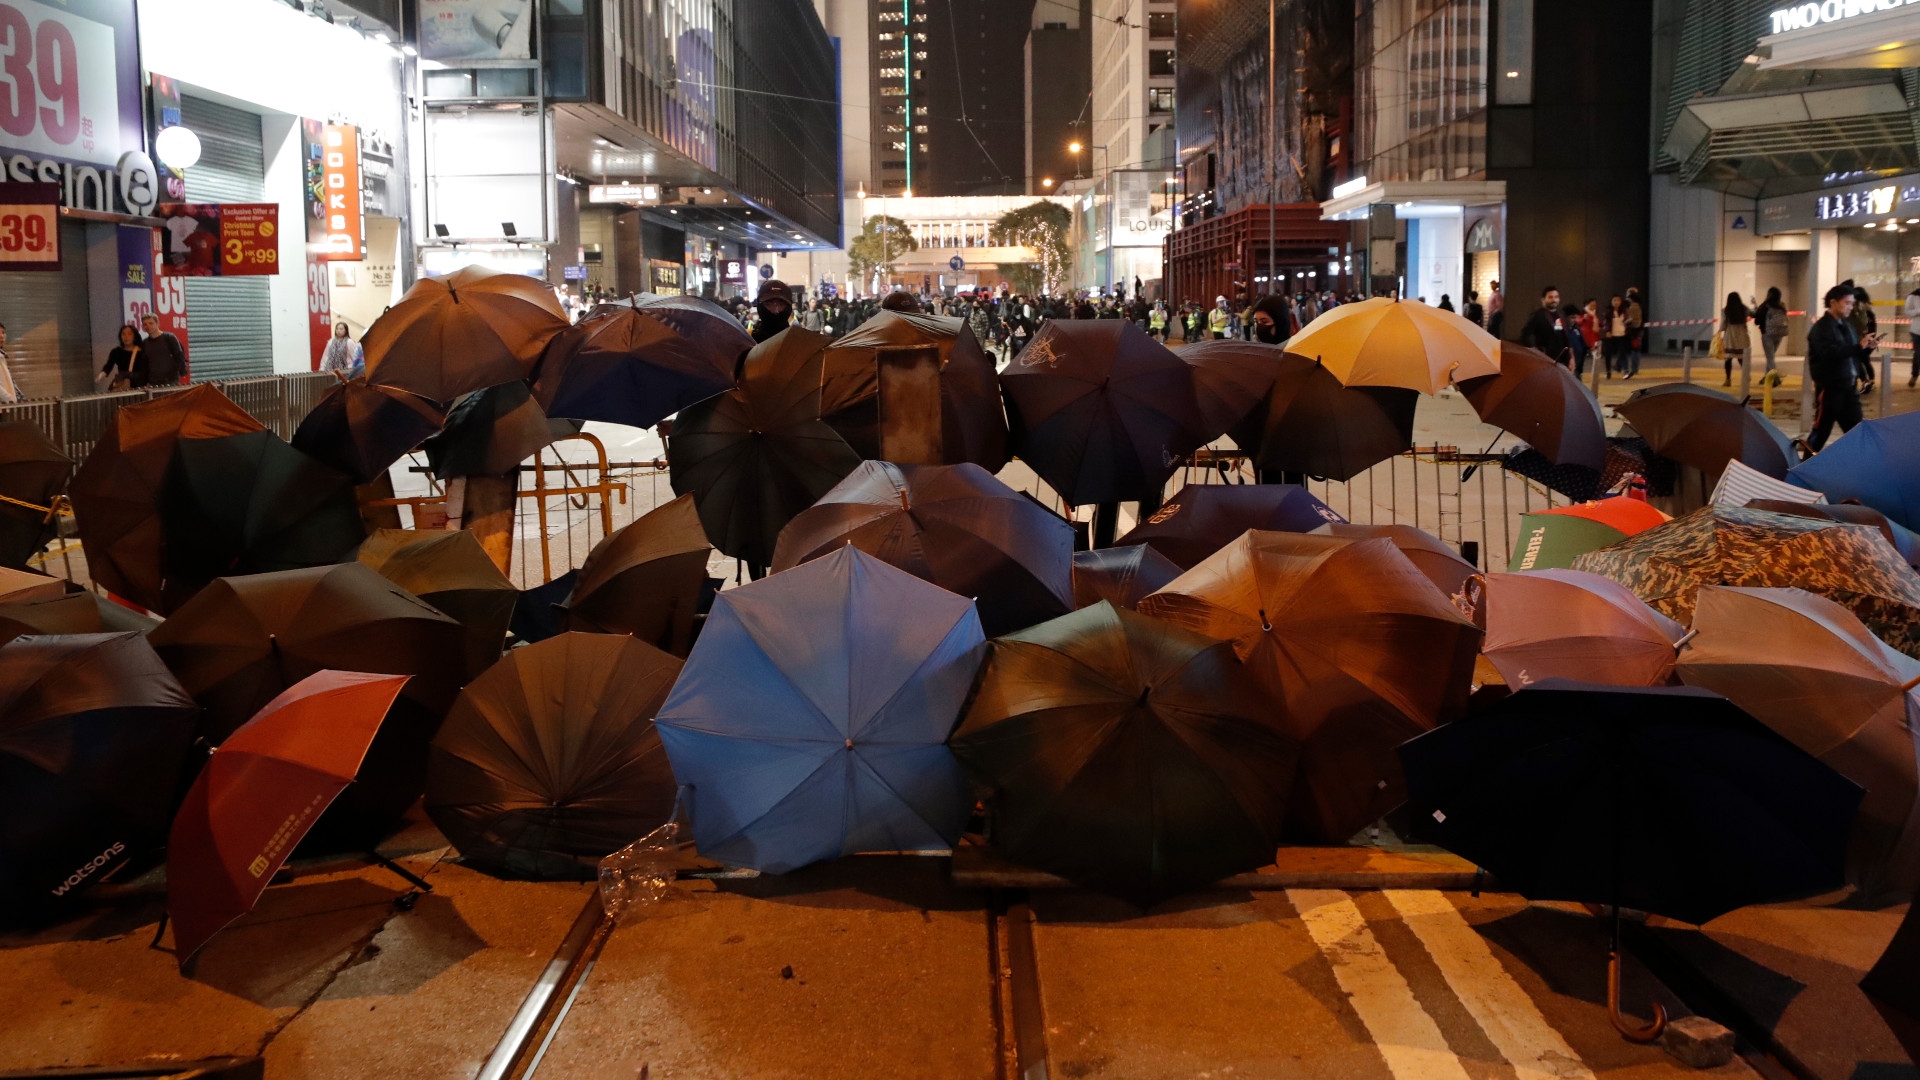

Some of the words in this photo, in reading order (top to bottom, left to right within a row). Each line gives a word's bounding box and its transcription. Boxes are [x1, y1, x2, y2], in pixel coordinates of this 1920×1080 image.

[1770, 2, 1819, 34] TWO
[0, 3, 80, 145] 39
[1, 214, 46, 252] 39
[1129, 220, 1173, 231] LOUIS
[225, 239, 243, 264] 3
[256, 249, 277, 263] 99
[127, 271, 146, 284] SALE
[308, 263, 329, 313] 39
[51, 841, 126, 896] watsons
